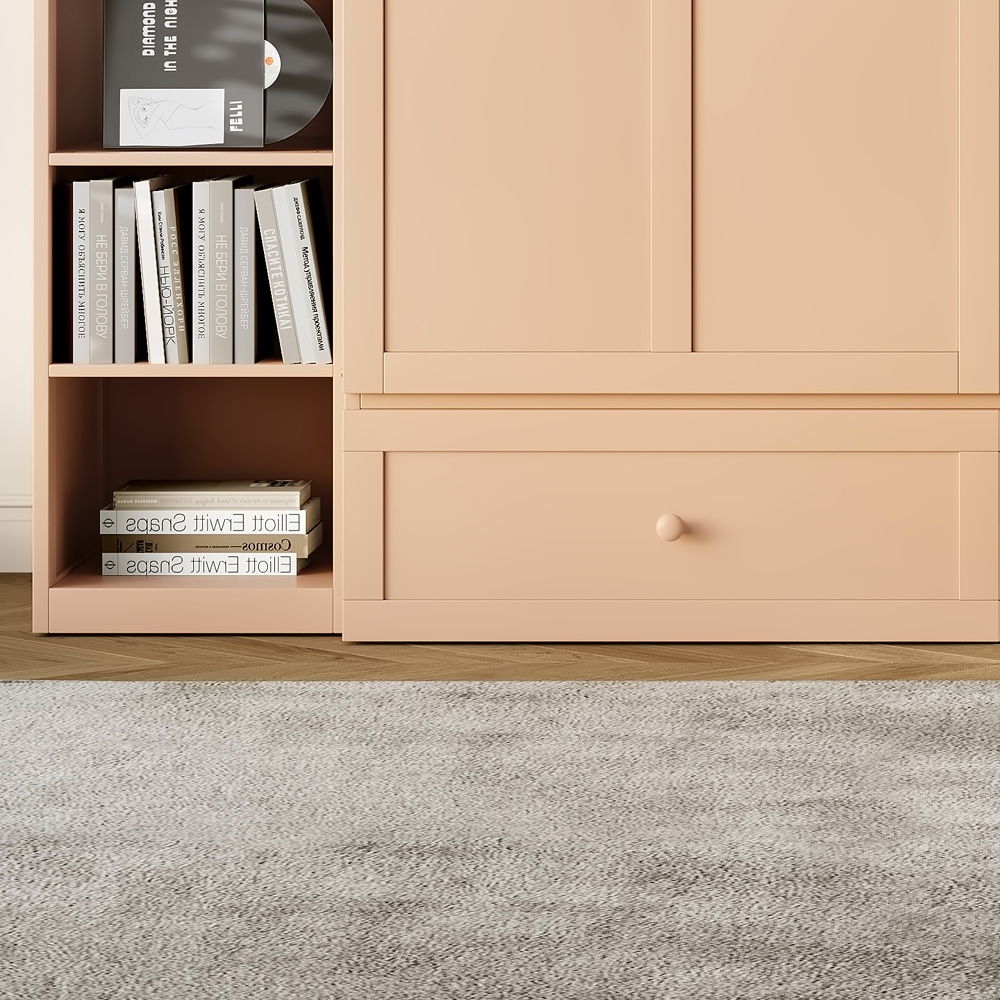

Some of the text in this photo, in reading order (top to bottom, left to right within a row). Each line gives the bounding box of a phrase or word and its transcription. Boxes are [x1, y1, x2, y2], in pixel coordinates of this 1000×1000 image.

[142, 1, 156, 57] DIAMOND
[164, 35, 177, 57] THE
[164, 60, 177, 72] IN
[229, 100, 243, 132] FELLI
[215, 234, 227, 249] НЕ
[240, 226, 249, 255] ДАВИД
[78, 244, 86, 299] ОБЪЯСНИТЬ
[95, 234, 107, 339] НЕ БЕРИ В ГОЛОВУ
[119, 225, 129, 330] ДАВИД СЕРВАН-ШРЕЙБЕР
[169, 225, 185, 333] РОСС ЭЛЛЕНХОРН
[215, 252, 227, 281] БЕРИ
[263, 228, 292, 330] СПАСИТЕ КОТИКА!
[159, 265, 176, 346] НЬЮ-ЙОРК
[215, 284, 227, 292] В
[301, 246, 311, 269] Метод
[311, 313, 325, 352] проектами
[78, 301, 86, 339] МНОГОЕ
[198, 301, 206, 339] МНОГОЕ
[215, 294, 227, 340] ГОЛОВУ
